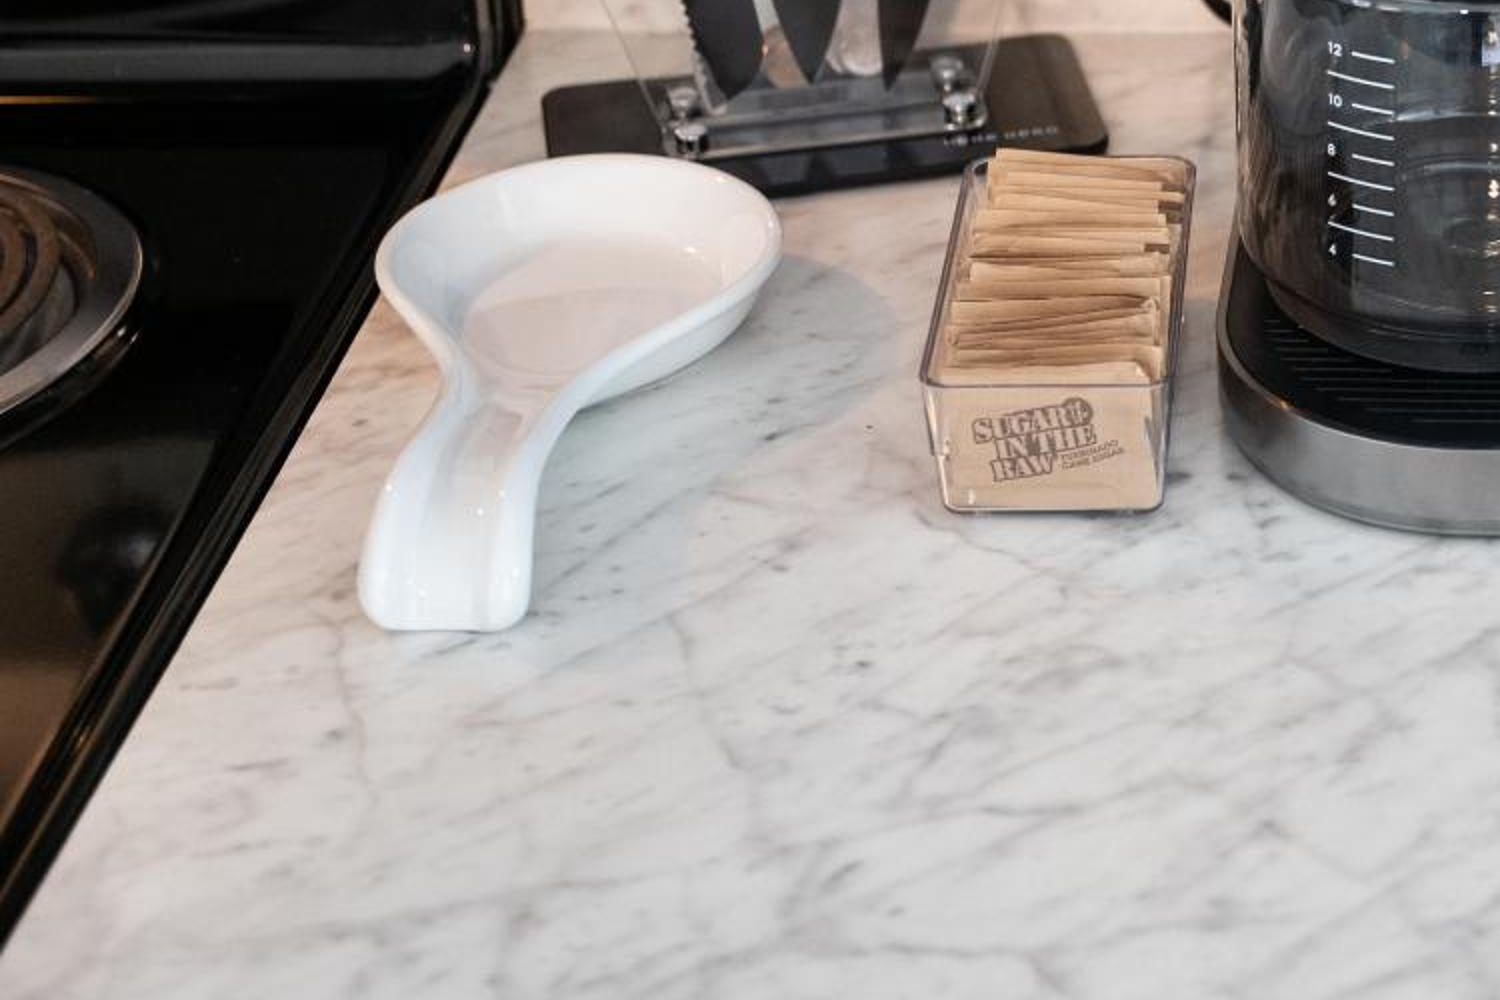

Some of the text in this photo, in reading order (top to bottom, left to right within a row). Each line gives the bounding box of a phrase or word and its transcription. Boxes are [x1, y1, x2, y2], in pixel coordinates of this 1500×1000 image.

[1327, 41, 1343, 58] 12
[1327, 92, 1343, 108] 10
[1327, 142, 1336, 156] 8
[1327, 192, 1337, 207] 6
[1328, 242, 1337, 256] 4
[972, 404, 1072, 444] SUGAR
[994, 424, 1097, 460] IN THE
[990, 455, 1054, 482] RAW
